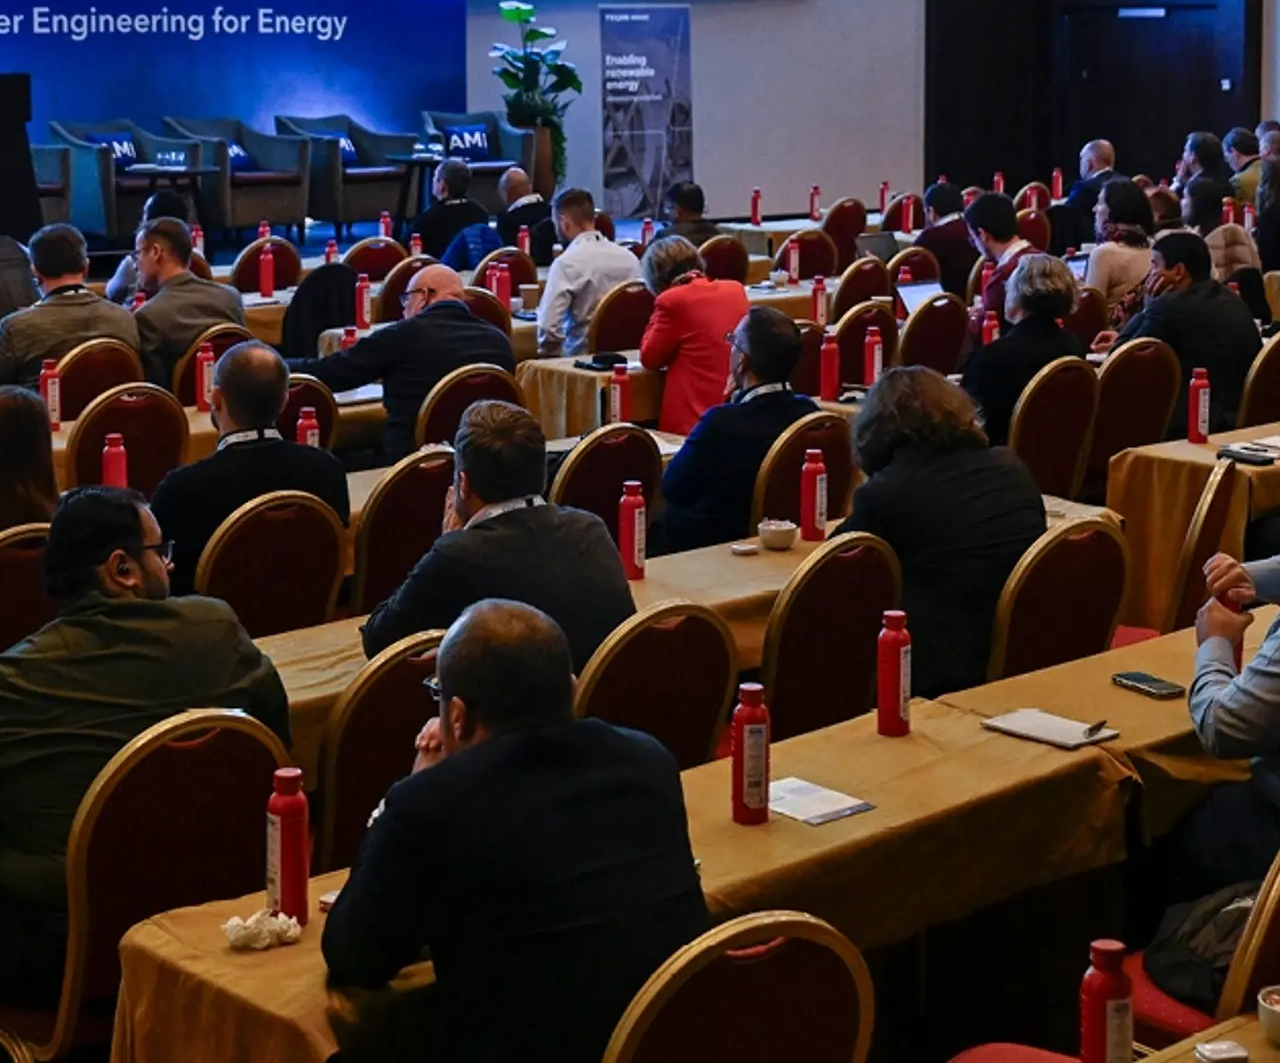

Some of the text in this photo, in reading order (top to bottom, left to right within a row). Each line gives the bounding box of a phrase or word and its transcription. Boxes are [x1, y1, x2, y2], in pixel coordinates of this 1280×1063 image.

[32, 7, 204, 41] Engineering
[211, 6, 251, 34] for
[257, 8, 348, 41] Energy
[606, 54, 647, 68] Enabling
[605, 67, 656, 78] renewable
[606, 81, 639, 92] energy
[449, 131, 488, 151] AMI
